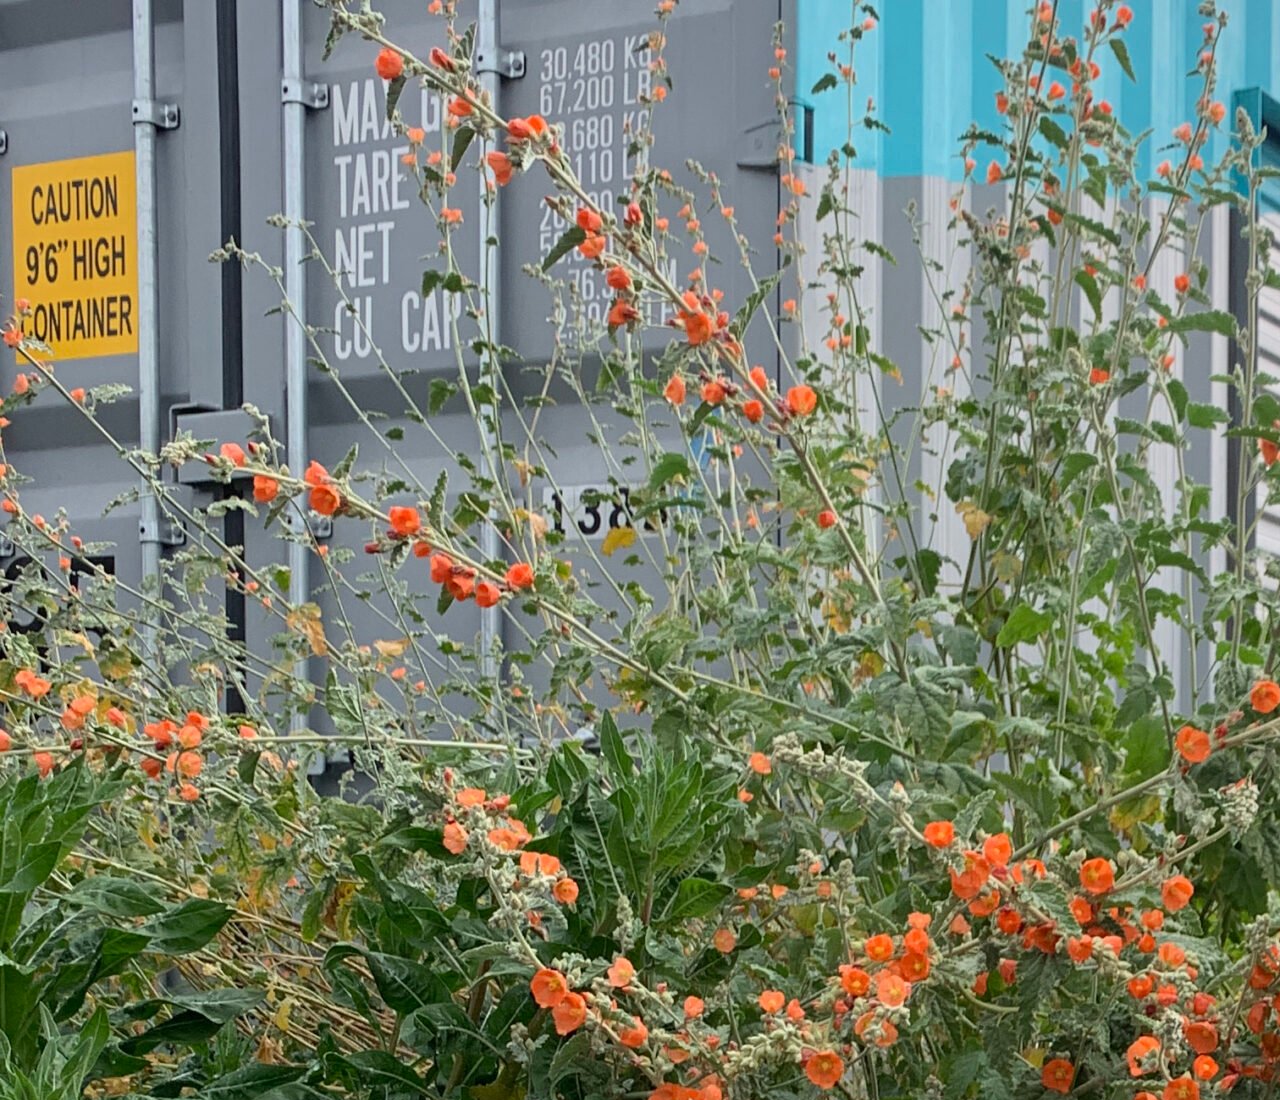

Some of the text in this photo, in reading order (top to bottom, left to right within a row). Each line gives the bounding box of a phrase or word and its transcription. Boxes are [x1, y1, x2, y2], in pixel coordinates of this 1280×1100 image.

[540, 33, 651, 82] 30,480 KG
[540, 75, 614, 116] 67,200
[31, 174, 118, 225] CAUTION
[334, 145, 410, 218] TARE
[73, 235, 126, 281] HIGH
[335, 221, 395, 288] NET
